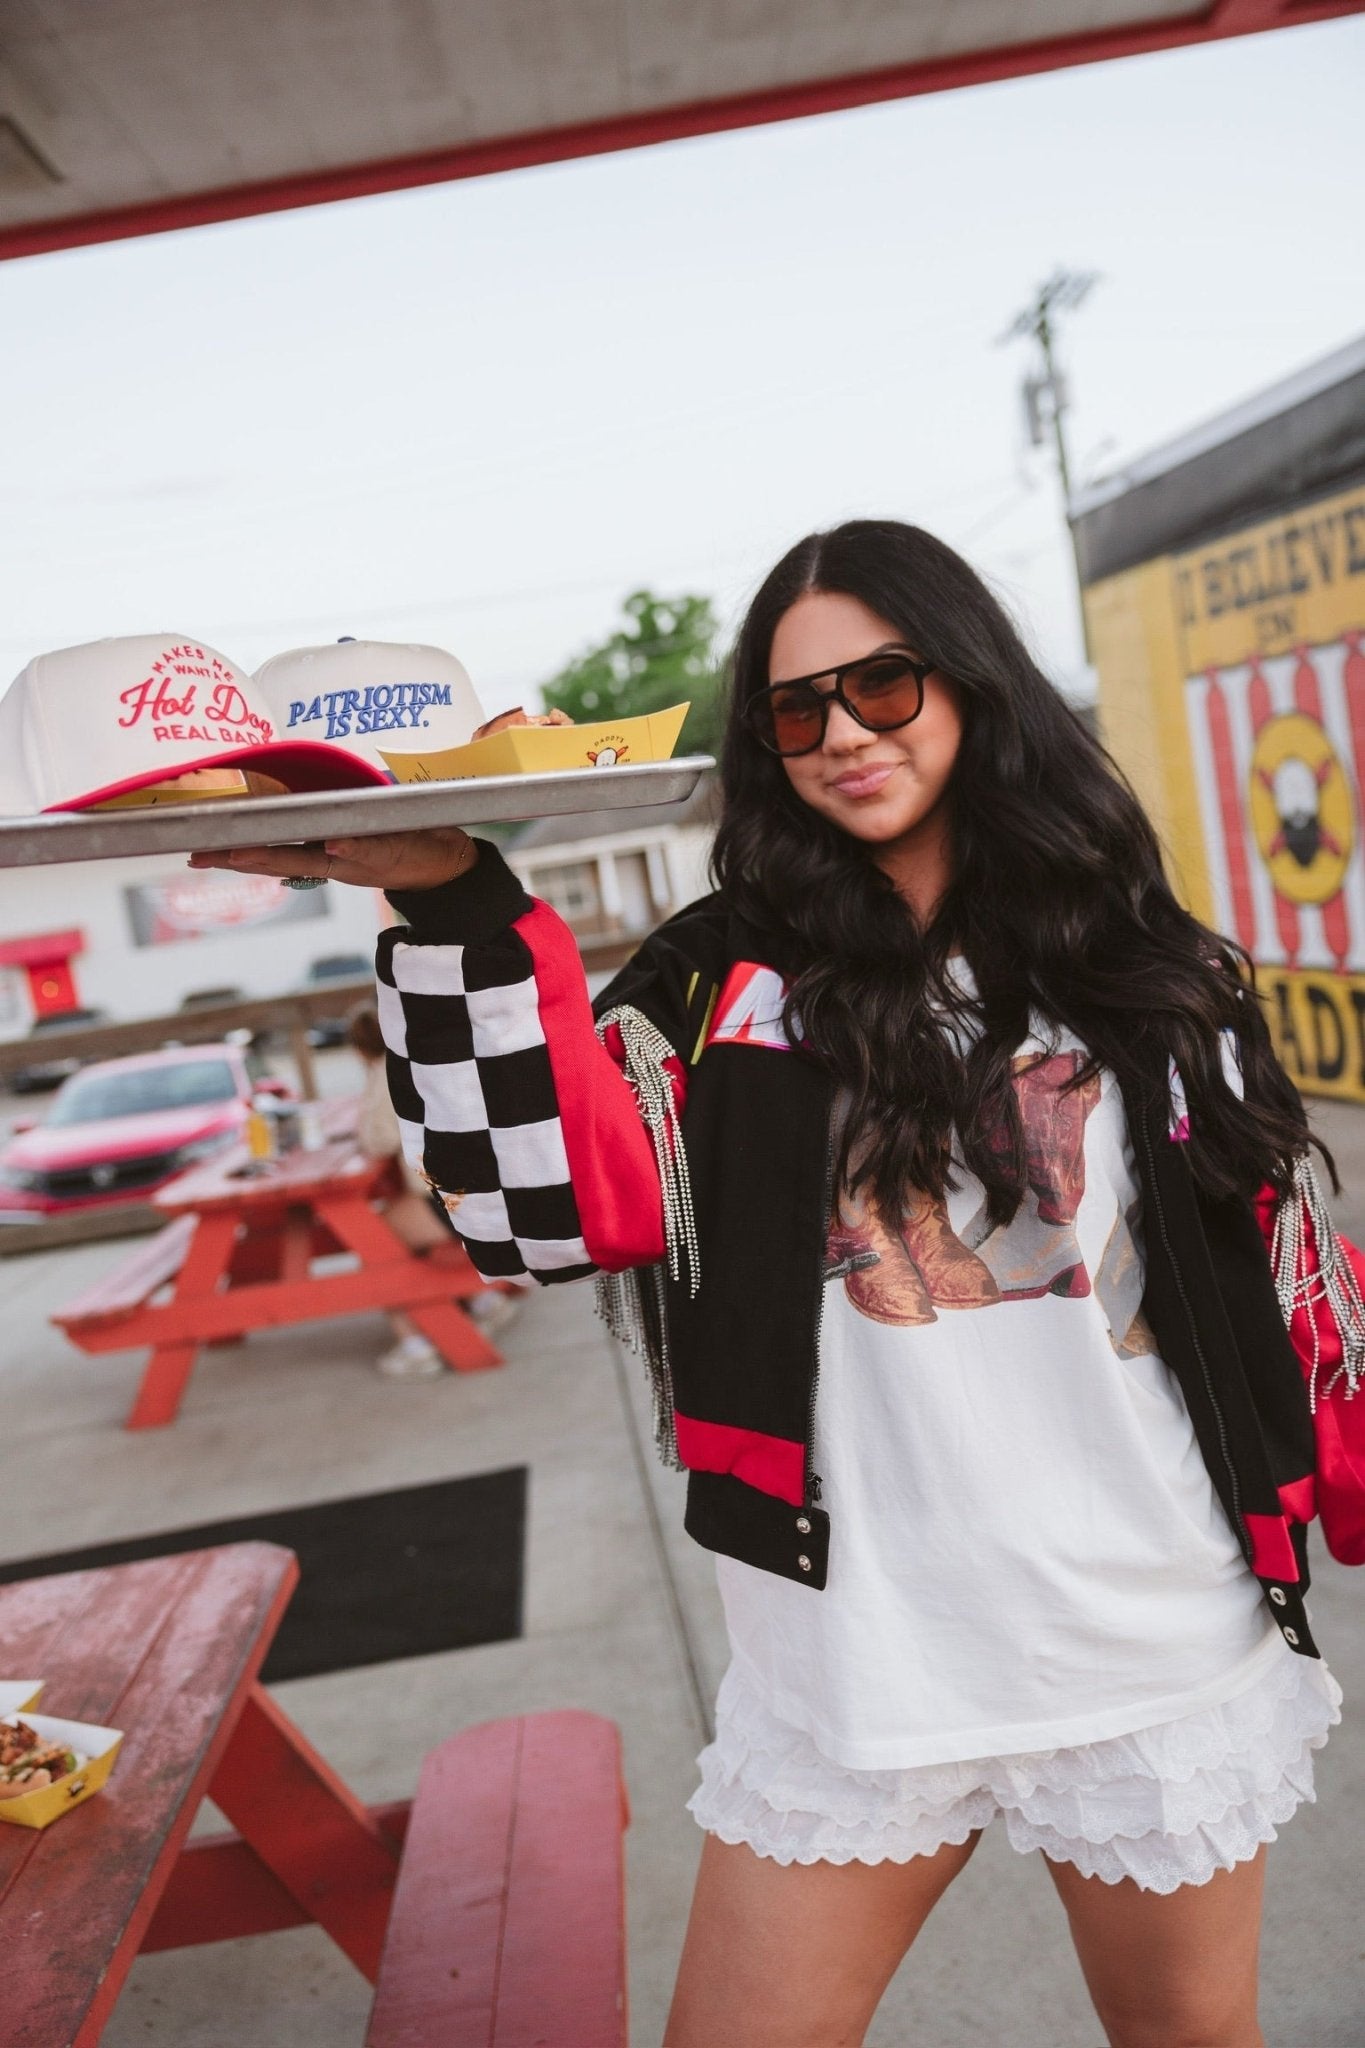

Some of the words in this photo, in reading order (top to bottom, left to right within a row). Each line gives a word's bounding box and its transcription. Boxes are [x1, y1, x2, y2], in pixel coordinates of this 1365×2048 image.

[152, 645, 205, 674] MAKES
[212, 658, 235, 682] ME
[118, 676, 197, 728] Hot
[204, 683, 274, 745] Dog
[286, 682, 453, 728] PATRIOTISM
[324, 712, 352, 740] IS
[356, 704, 430, 735] SEXY.
[152, 724, 217, 742] REAL
[218, 726, 260, 745] BAD
